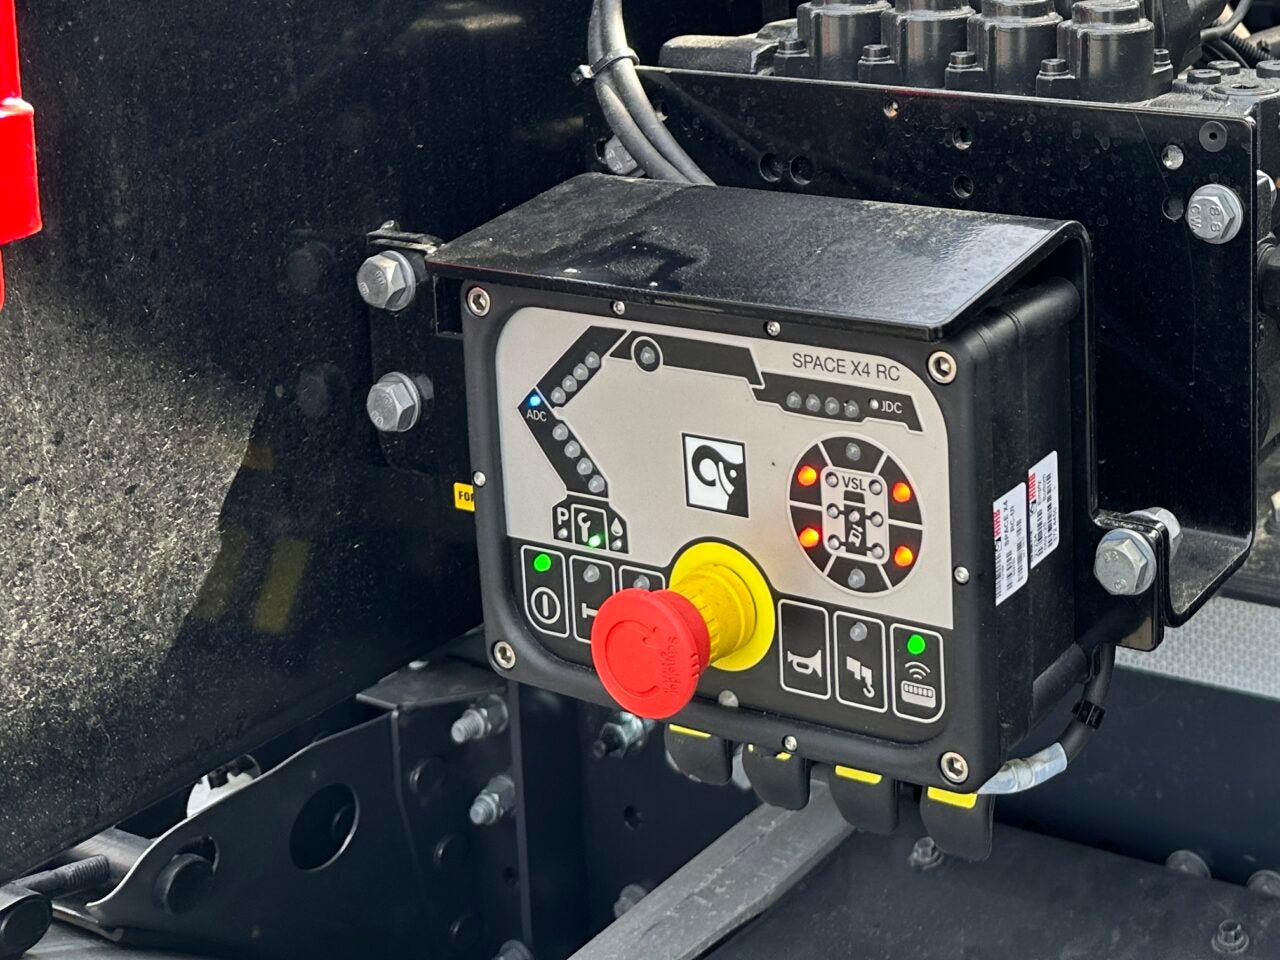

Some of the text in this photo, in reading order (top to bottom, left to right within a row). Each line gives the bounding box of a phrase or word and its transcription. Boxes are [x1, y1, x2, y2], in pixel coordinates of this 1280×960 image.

[792, 353, 901, 382] SPACE X4 RC
[526, 408, 548, 424] ADC
[881, 400, 902, 414] JDC
[842, 474, 867, 492] VSL
[557, 507, 570, 525] P
[667, 636, 680, 694] Schneider
